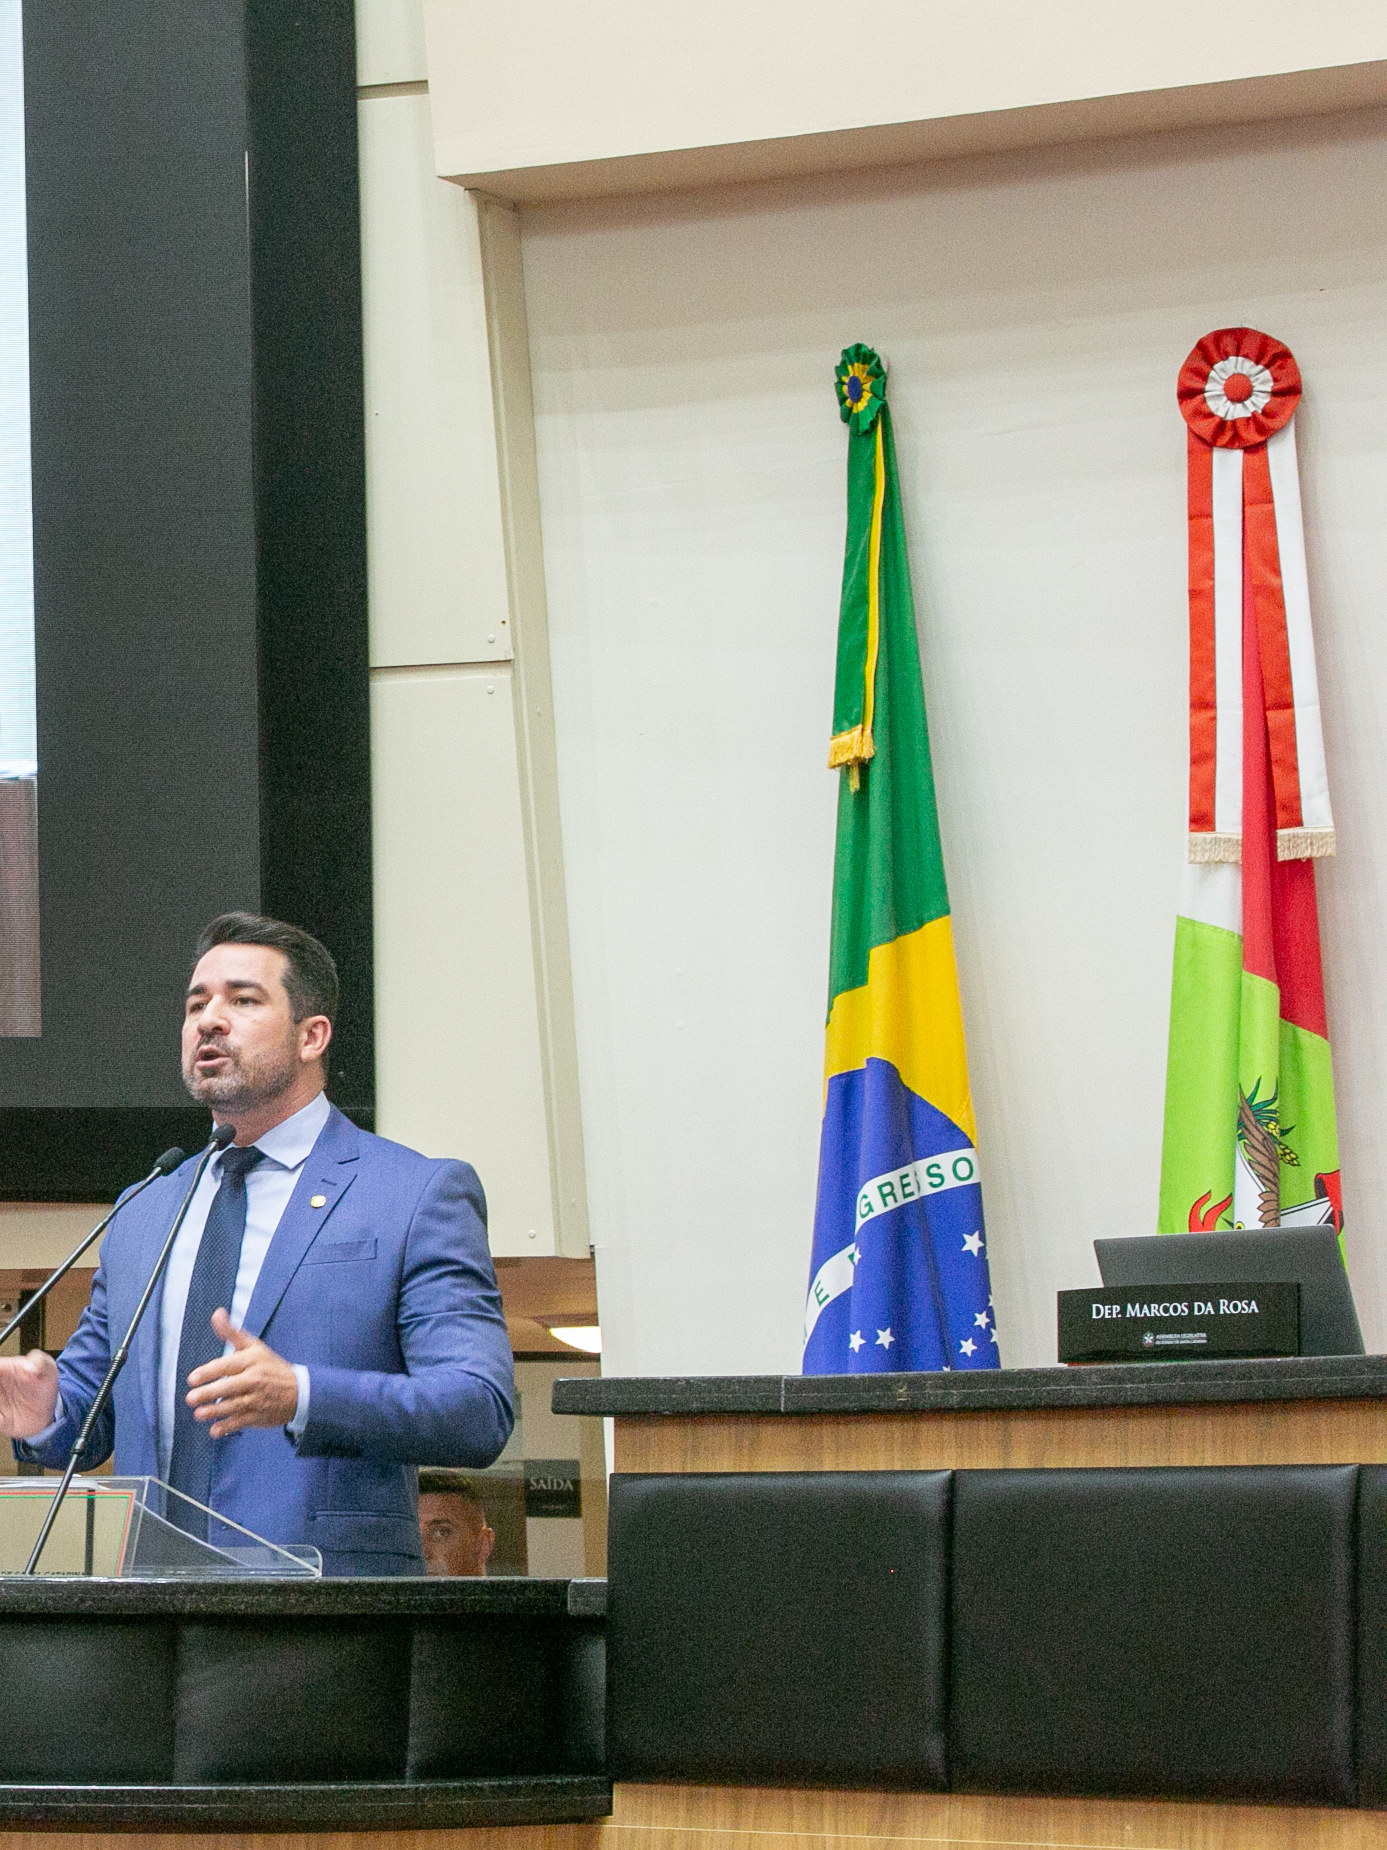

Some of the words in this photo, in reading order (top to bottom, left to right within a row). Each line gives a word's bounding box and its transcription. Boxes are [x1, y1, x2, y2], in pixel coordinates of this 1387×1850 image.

[1125, 1302, 1189, 1318] MARCOS
[1219, 1298, 1260, 1315] ROSA
[529, 1475, 574, 1491] SAÍDA
